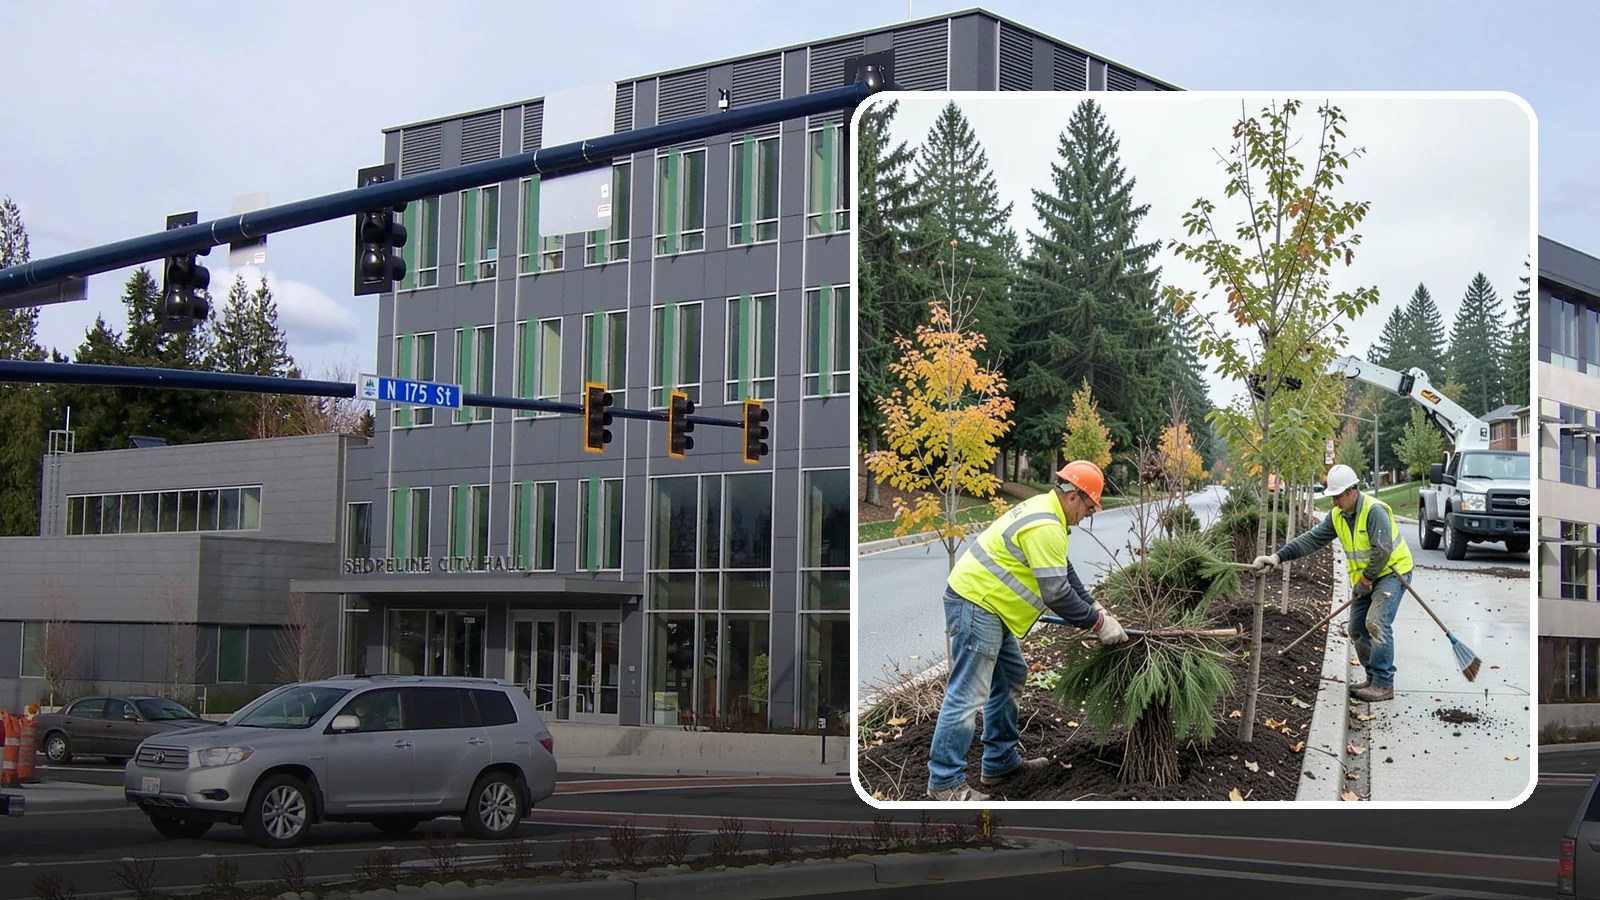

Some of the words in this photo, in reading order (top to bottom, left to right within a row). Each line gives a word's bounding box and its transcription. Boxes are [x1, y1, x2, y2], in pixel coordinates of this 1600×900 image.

[387, 380, 396, 399] N
[405, 382, 427, 403] 175
[436, 386, 451, 406] St
[344, 556, 432, 574] SHORELINE
[438, 556, 475, 572] CITY
[483, 555, 525, 571] HALL
